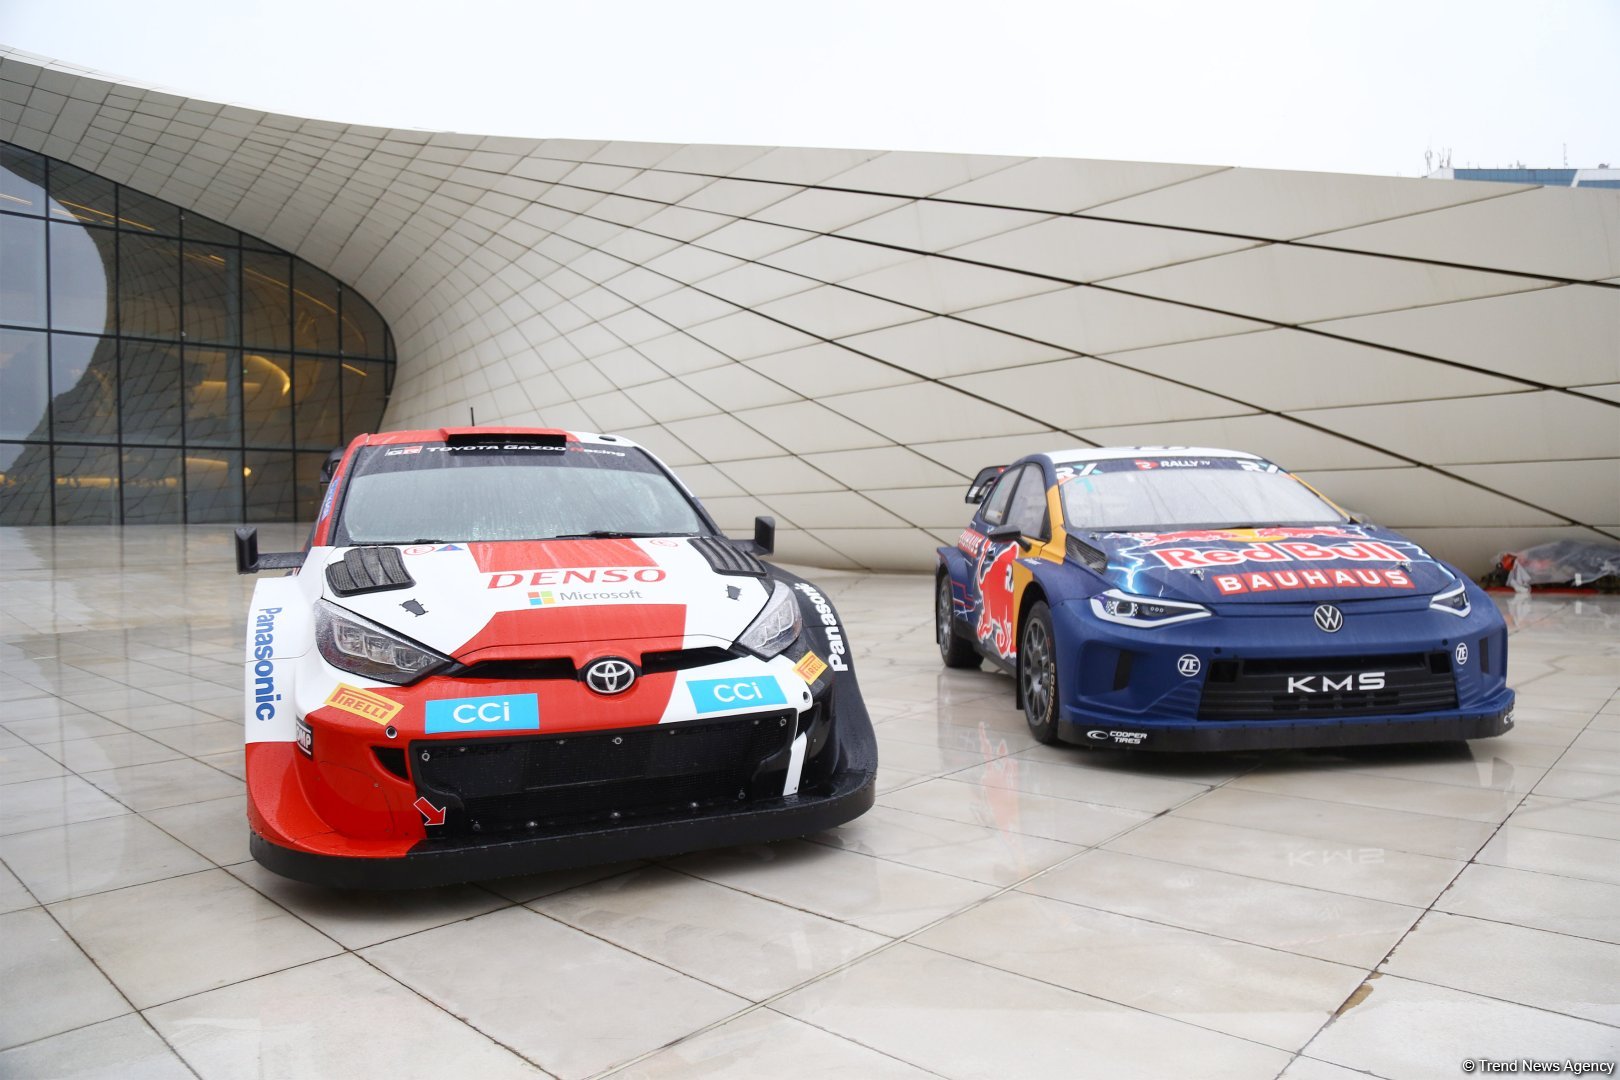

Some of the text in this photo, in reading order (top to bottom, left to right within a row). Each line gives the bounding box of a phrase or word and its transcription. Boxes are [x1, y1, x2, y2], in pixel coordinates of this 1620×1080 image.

[426, 445, 499, 453] TOYOTA
[503, 444, 567, 452] GAZOO
[570, 447, 626, 457] Racing
[1160, 459, 1199, 468] RALLY
[1154, 541, 1412, 569] Red Bull
[487, 569, 667, 589] DENSO
[1218, 569, 1410, 593] BAUHAUS
[560, 588, 642, 602] Microsoft
[254, 607, 283, 721] Panasonic
[797, 655, 823, 681] PIRELLI
[1287, 672, 1386, 693] KMS
[330, 687, 396, 720] PIRELLI
[1109, 730, 1148, 740] COOPER
[1114, 737, 1142, 745] TIRES
